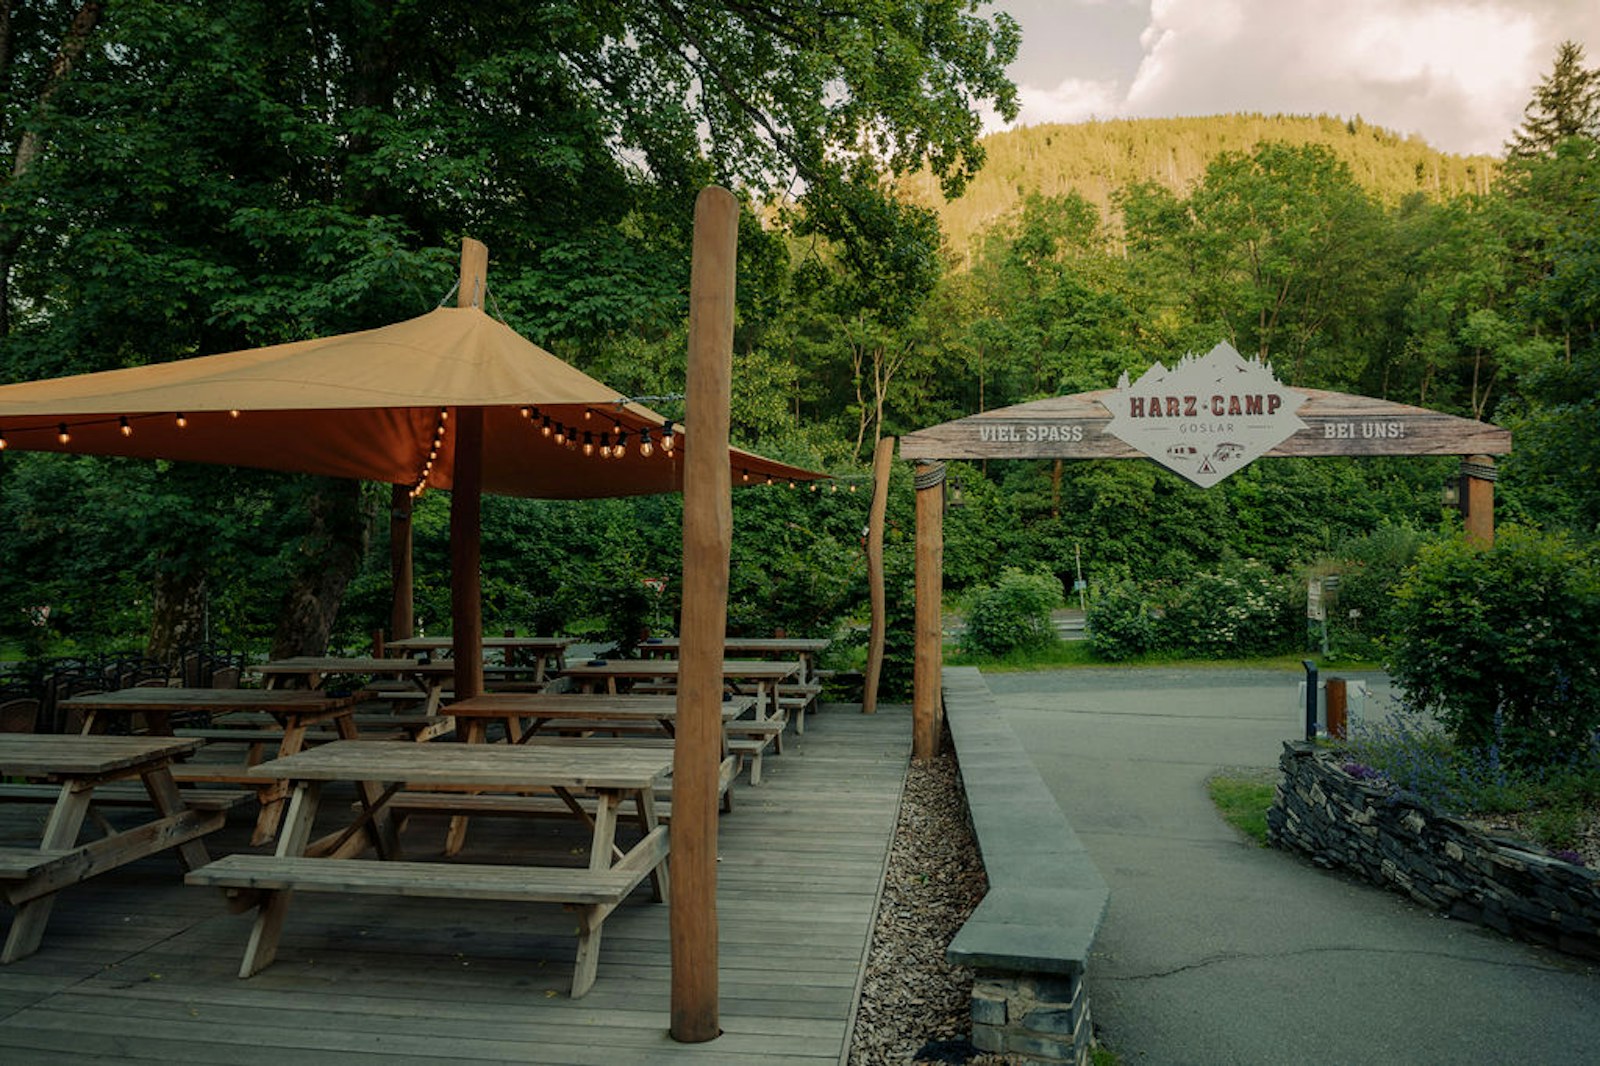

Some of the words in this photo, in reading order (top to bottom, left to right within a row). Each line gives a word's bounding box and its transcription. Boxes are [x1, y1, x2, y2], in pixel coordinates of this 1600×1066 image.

[1129, 396, 1197, 418] HARZ
[1210, 394, 1282, 416] CAMP
[979, 425, 1020, 442] VIEL
[1026, 425, 1083, 442] SPASS
[1179, 423, 1234, 434] GOSLAR
[1324, 422, 1356, 439] BEI
[1361, 422, 1405, 439] UNS!
